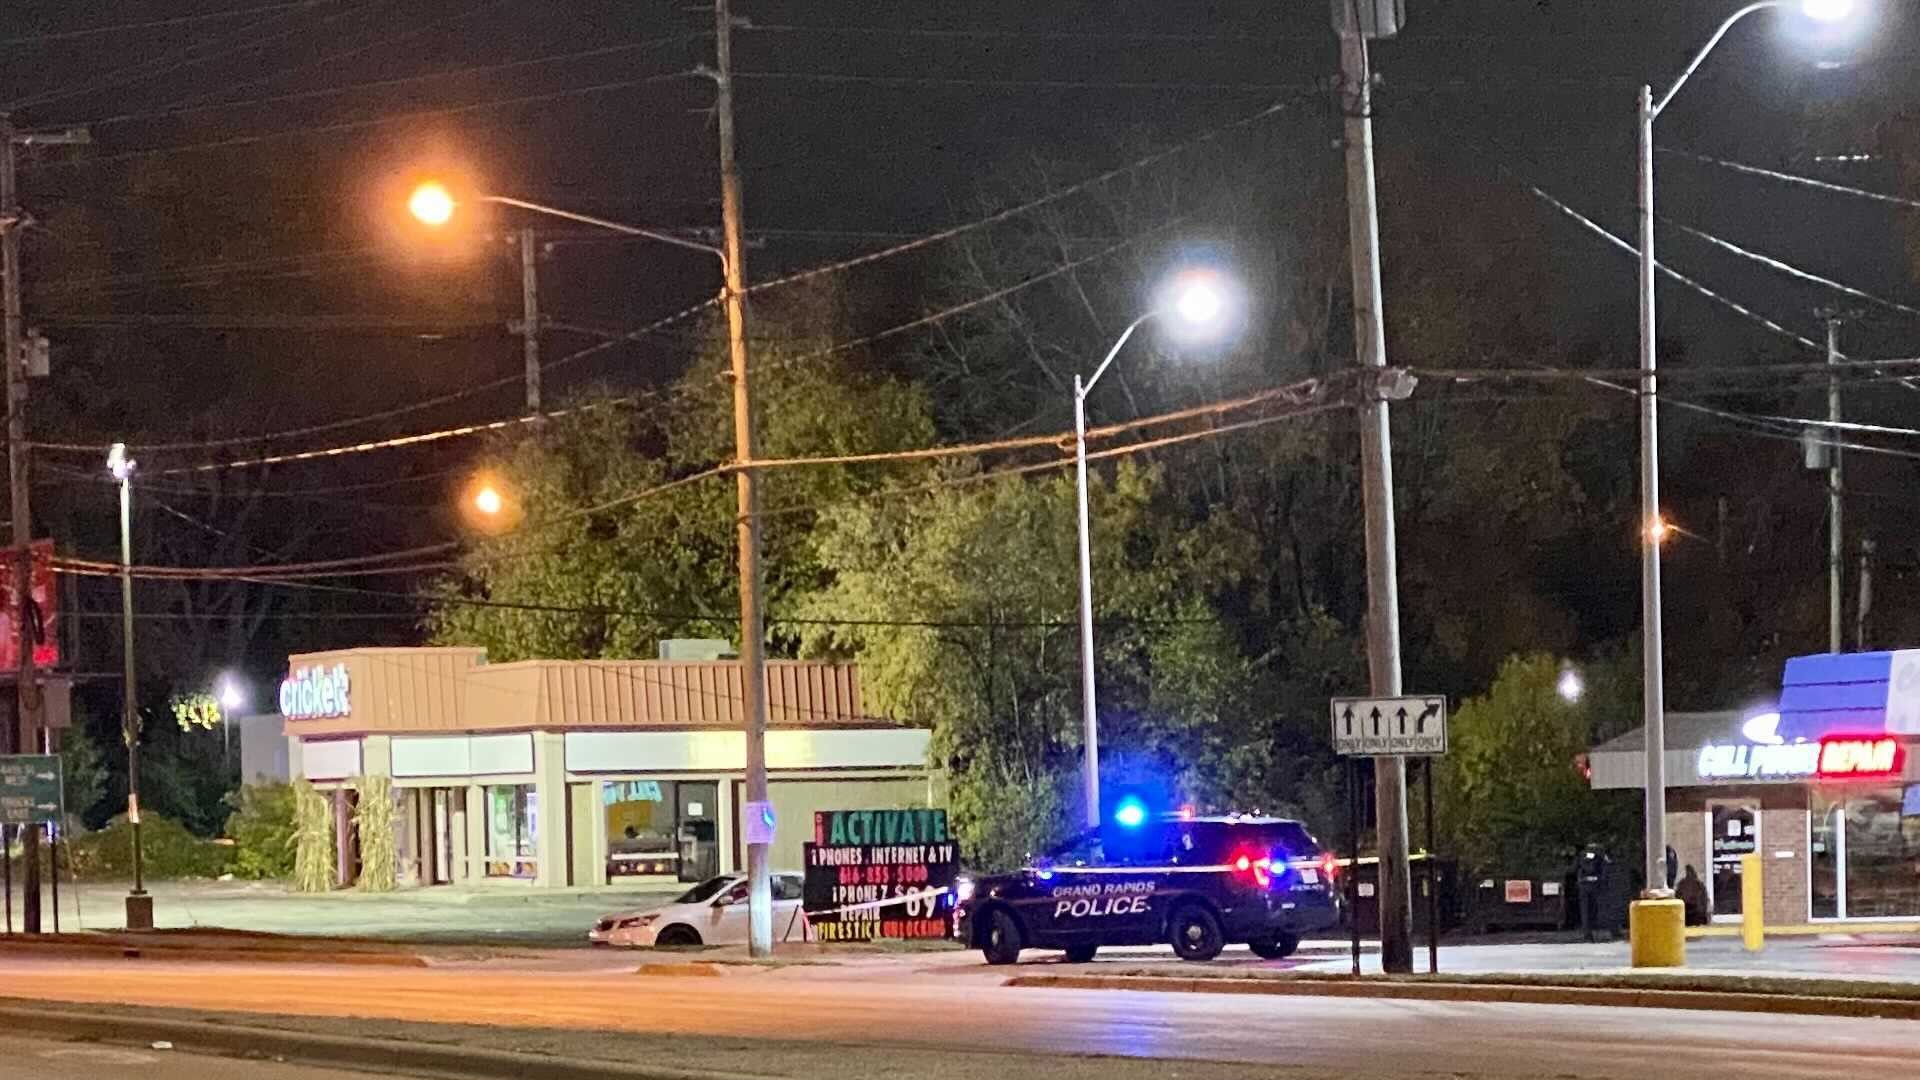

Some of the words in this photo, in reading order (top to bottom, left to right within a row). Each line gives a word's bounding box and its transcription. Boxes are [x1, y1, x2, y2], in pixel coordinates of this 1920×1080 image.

[280, 664, 351, 717] cricket
[1337, 739, 1361, 751] ONLY
[1364, 738, 1388, 750] ONLY
[1391, 738, 1415, 749] ONLY
[1418, 737, 1441, 749] ONLY
[831, 811, 945, 845] ACTIVATE
[871, 845, 925, 865] INTERNET
[928, 846, 937, 863] &
[939, 845, 952, 863] TV
[1053, 884, 1101, 898] GRAND
[1104, 881, 1155, 896] RAPIDS
[1054, 896, 1149, 918] POLICE
[817, 920, 882, 942] FIRESTICK
